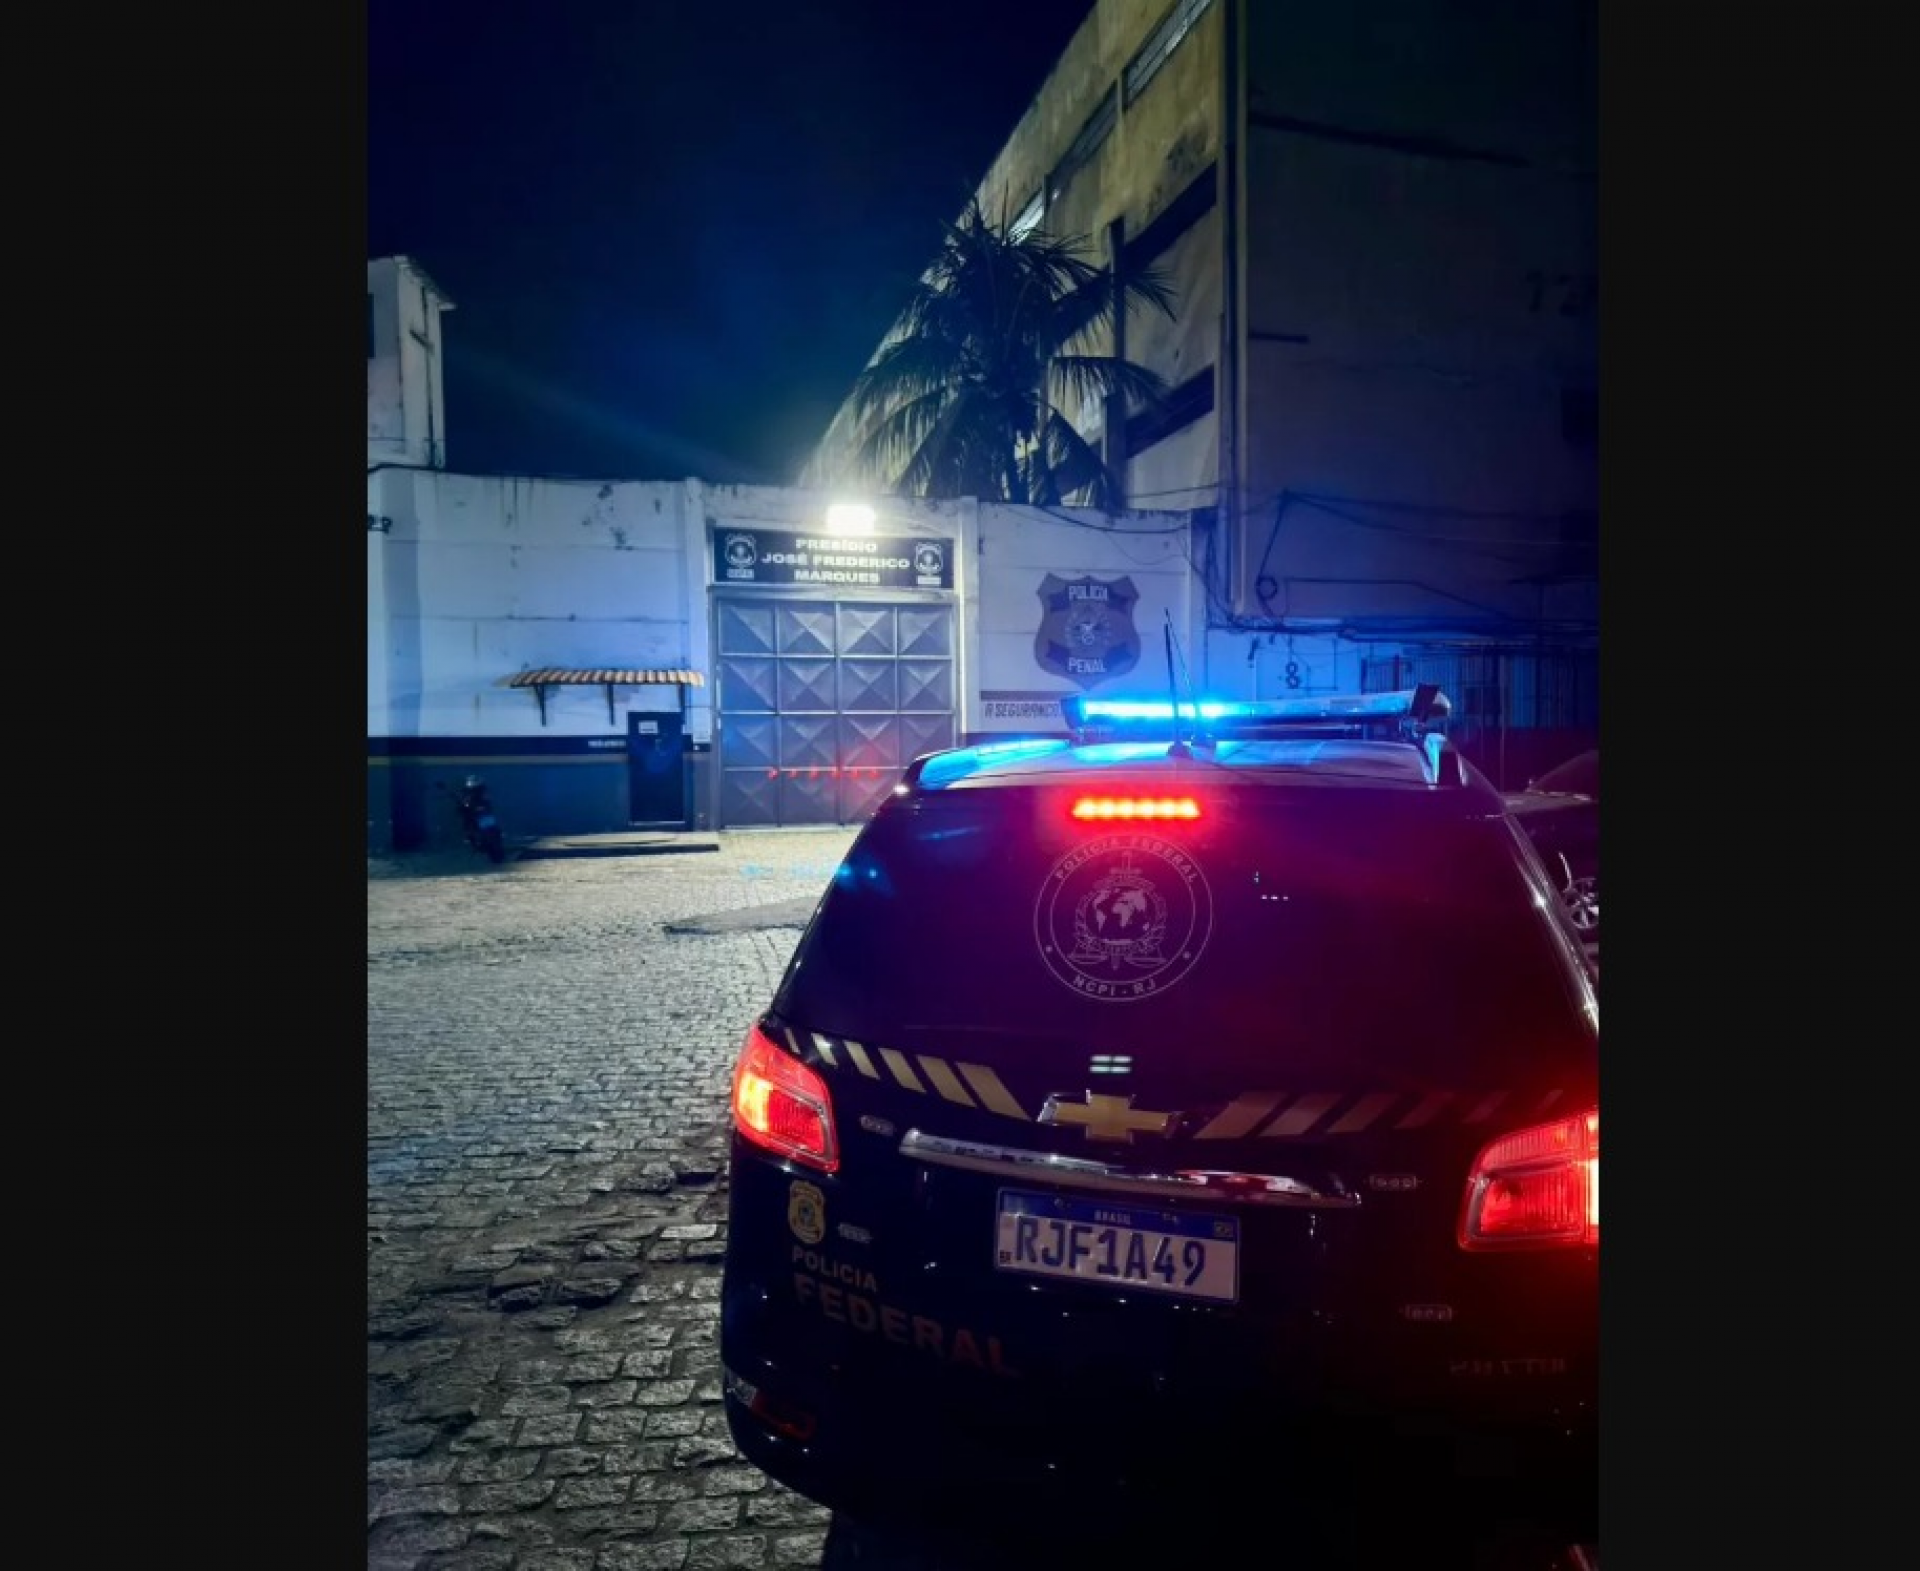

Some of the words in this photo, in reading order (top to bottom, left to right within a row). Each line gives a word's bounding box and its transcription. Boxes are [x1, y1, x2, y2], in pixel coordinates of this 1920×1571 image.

[761, 551, 808, 566] JOSÉ
[812, 554, 911, 570] FREDERICO
[794, 568, 881, 584] MARQUES
[1068, 656, 1106, 674] PENAL
[1131, 837, 1198, 883] FEDERAL
[1015, 1215, 1206, 1287] RJF1A49
[793, 1272, 1023, 1379] FEDERAL
